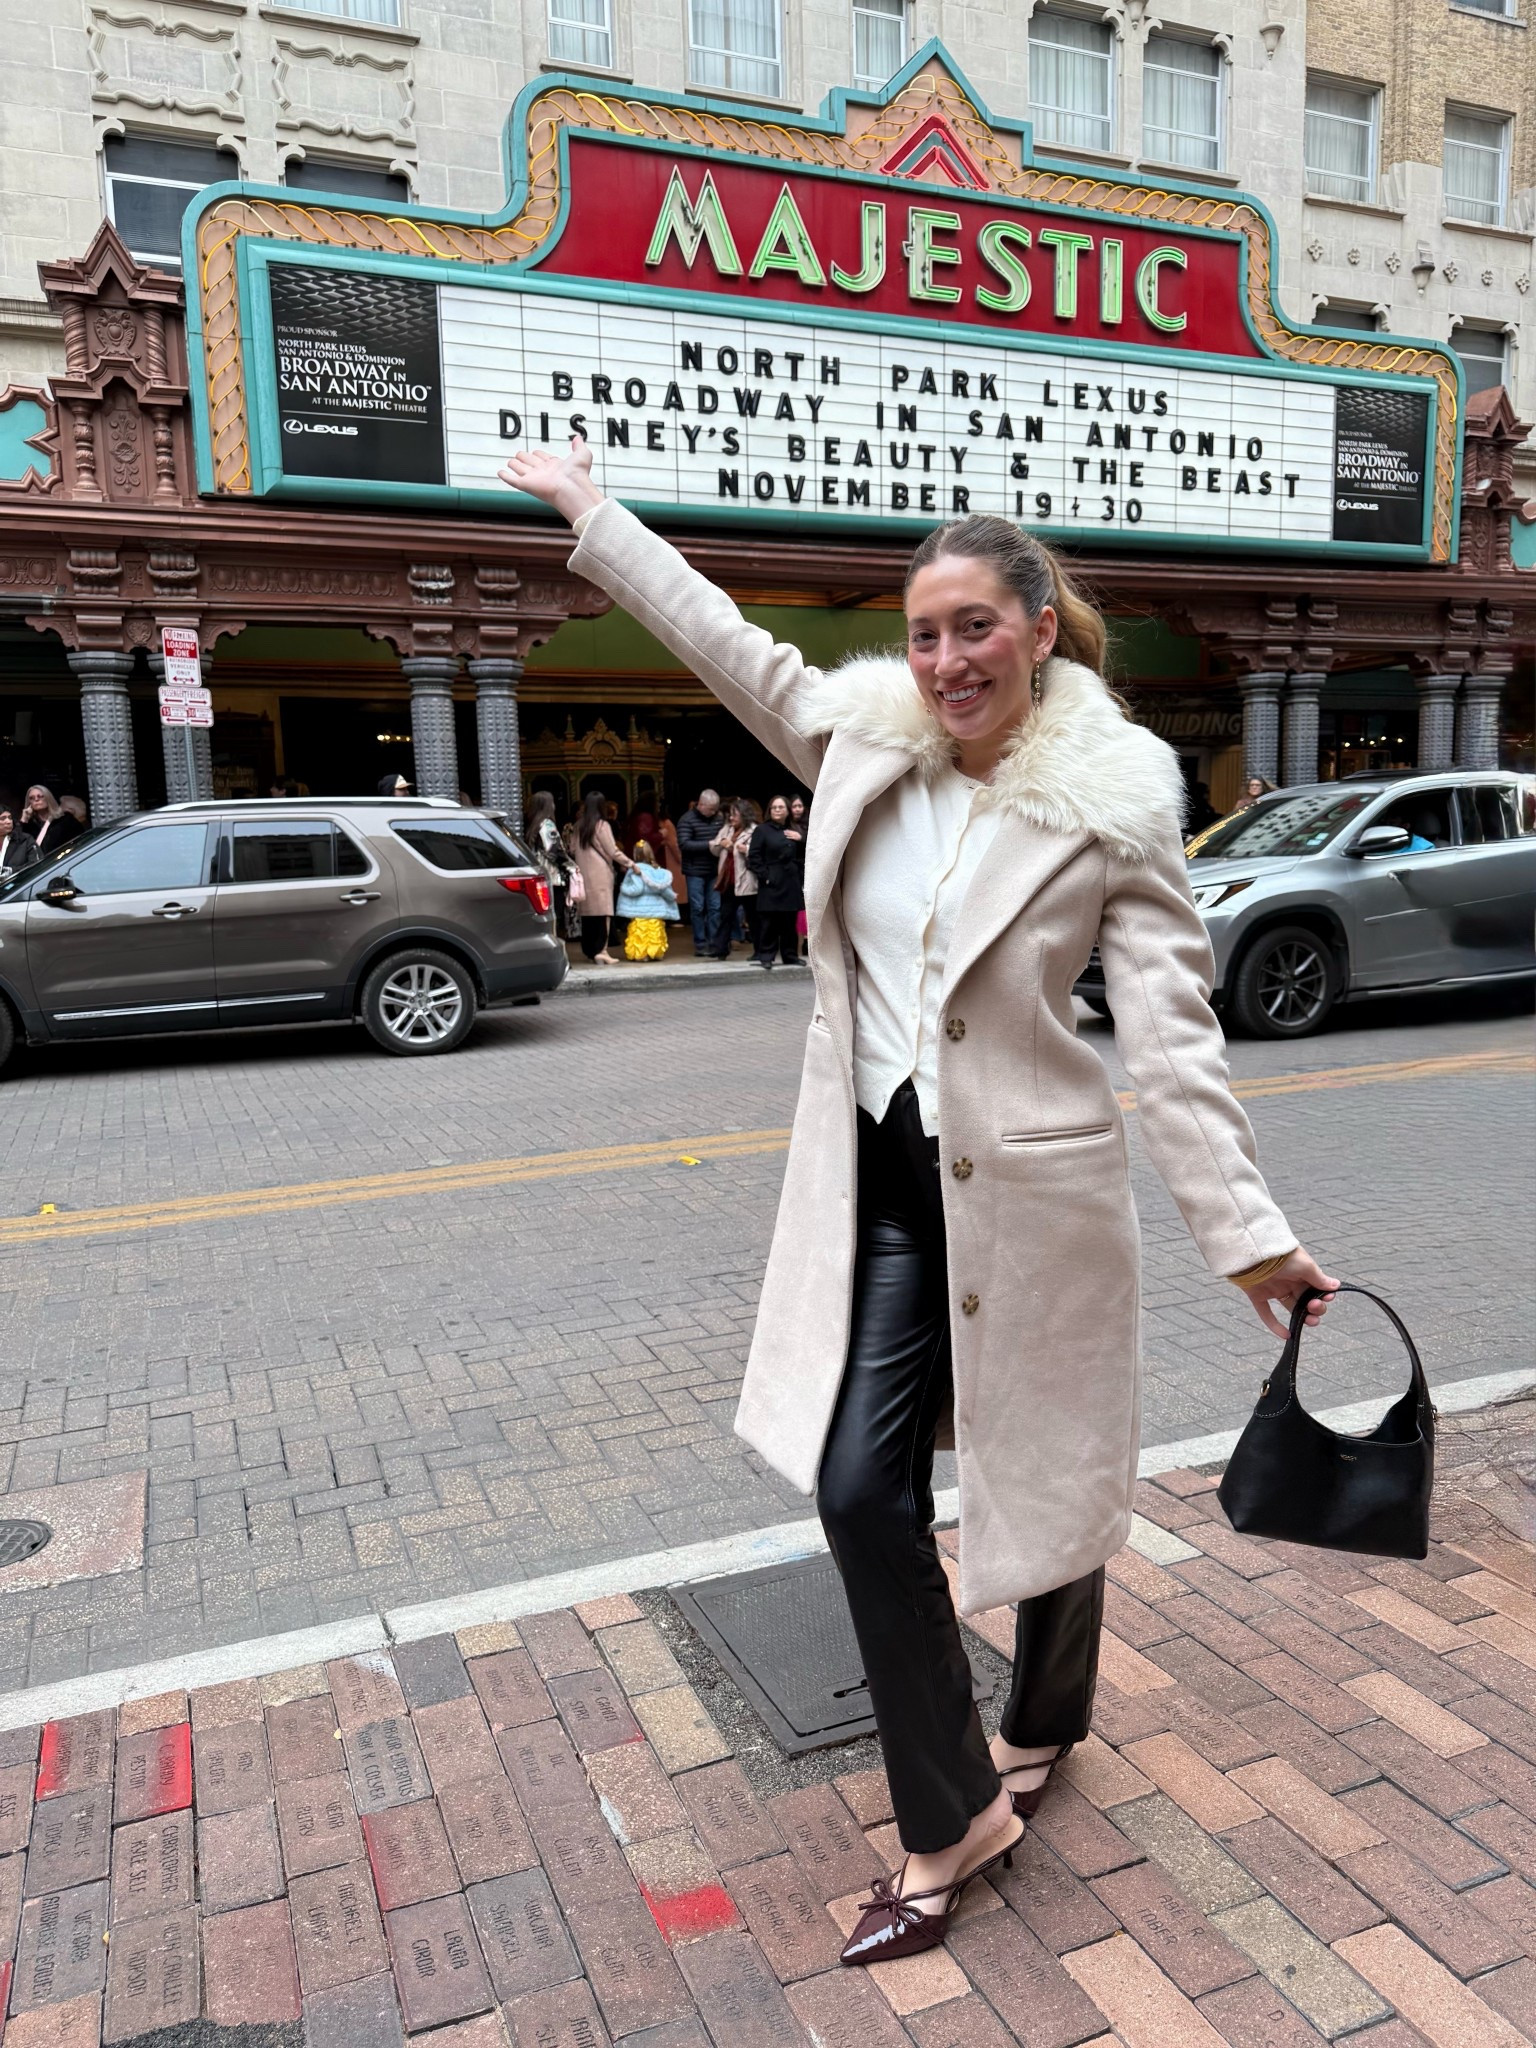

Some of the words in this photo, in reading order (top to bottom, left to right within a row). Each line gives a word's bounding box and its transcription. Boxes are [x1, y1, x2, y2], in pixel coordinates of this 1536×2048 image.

[645, 165, 1187, 333] MAJESTIC
[277, 325, 303, 335] PROUD
[304, 328, 338, 337] SPONSOR
[278, 339, 311, 349] NORTH
[315, 342, 338, 351] PARK
[339, 344, 366, 353] LEXUS
[278, 347, 296, 356] SAN
[299, 349, 343, 360] ANTONIO
[345, 353, 353, 361] &
[354, 354, 405, 365] DOMINION
[280, 356, 391, 380] BROADWAY
[394, 372, 406, 382] IN
[280, 374, 320, 392] SAN
[681, 340, 840, 385] NORTH
[892, 364, 998, 401] PARK
[1043, 380, 1168, 416] LEXUS
[312, 397, 321, 405] AT
[323, 398, 340, 406] THE
[342, 399, 392, 411] MAJESTIC
[394, 404, 427, 413] THEATRE
[552, 370, 824, 424] BROADWAY
[876, 402, 917, 431] IN
[968, 409, 1043, 443] SAN
[1087, 421, 1263, 461] ANTONIO
[304, 424, 358, 435] LEXUS
[788, 434, 968, 474] BEAUTY
[1011, 452, 1028, 479] &
[1073, 457, 1143, 487] THE
[1182, 466, 1299, 497] BEAST
[1337, 465, 1360, 479] SAN
[1338, 453, 1400, 469] BROADWAY
[718, 468, 970, 513] NOVEMBER
[166, 641, 195, 651] LOADING
[172, 649, 190, 657] ZONE
[381, 1717, 403, 1750] MAYOR
[364, 1764, 386, 1801] COLYER
[389, 1752, 416, 1797] EMERITUS
[129, 1839, 148, 1868] KYLE
[160, 1825, 179, 1894] CHRISTOPHER
[129, 1870, 148, 1893] SELF
[338, 1883, 363, 1936] MICHAEL
[524, 1898, 555, 1950] VIRGINIA
[411, 1938, 438, 1979] GIROIR
[443, 1929, 470, 1971] LAURA
